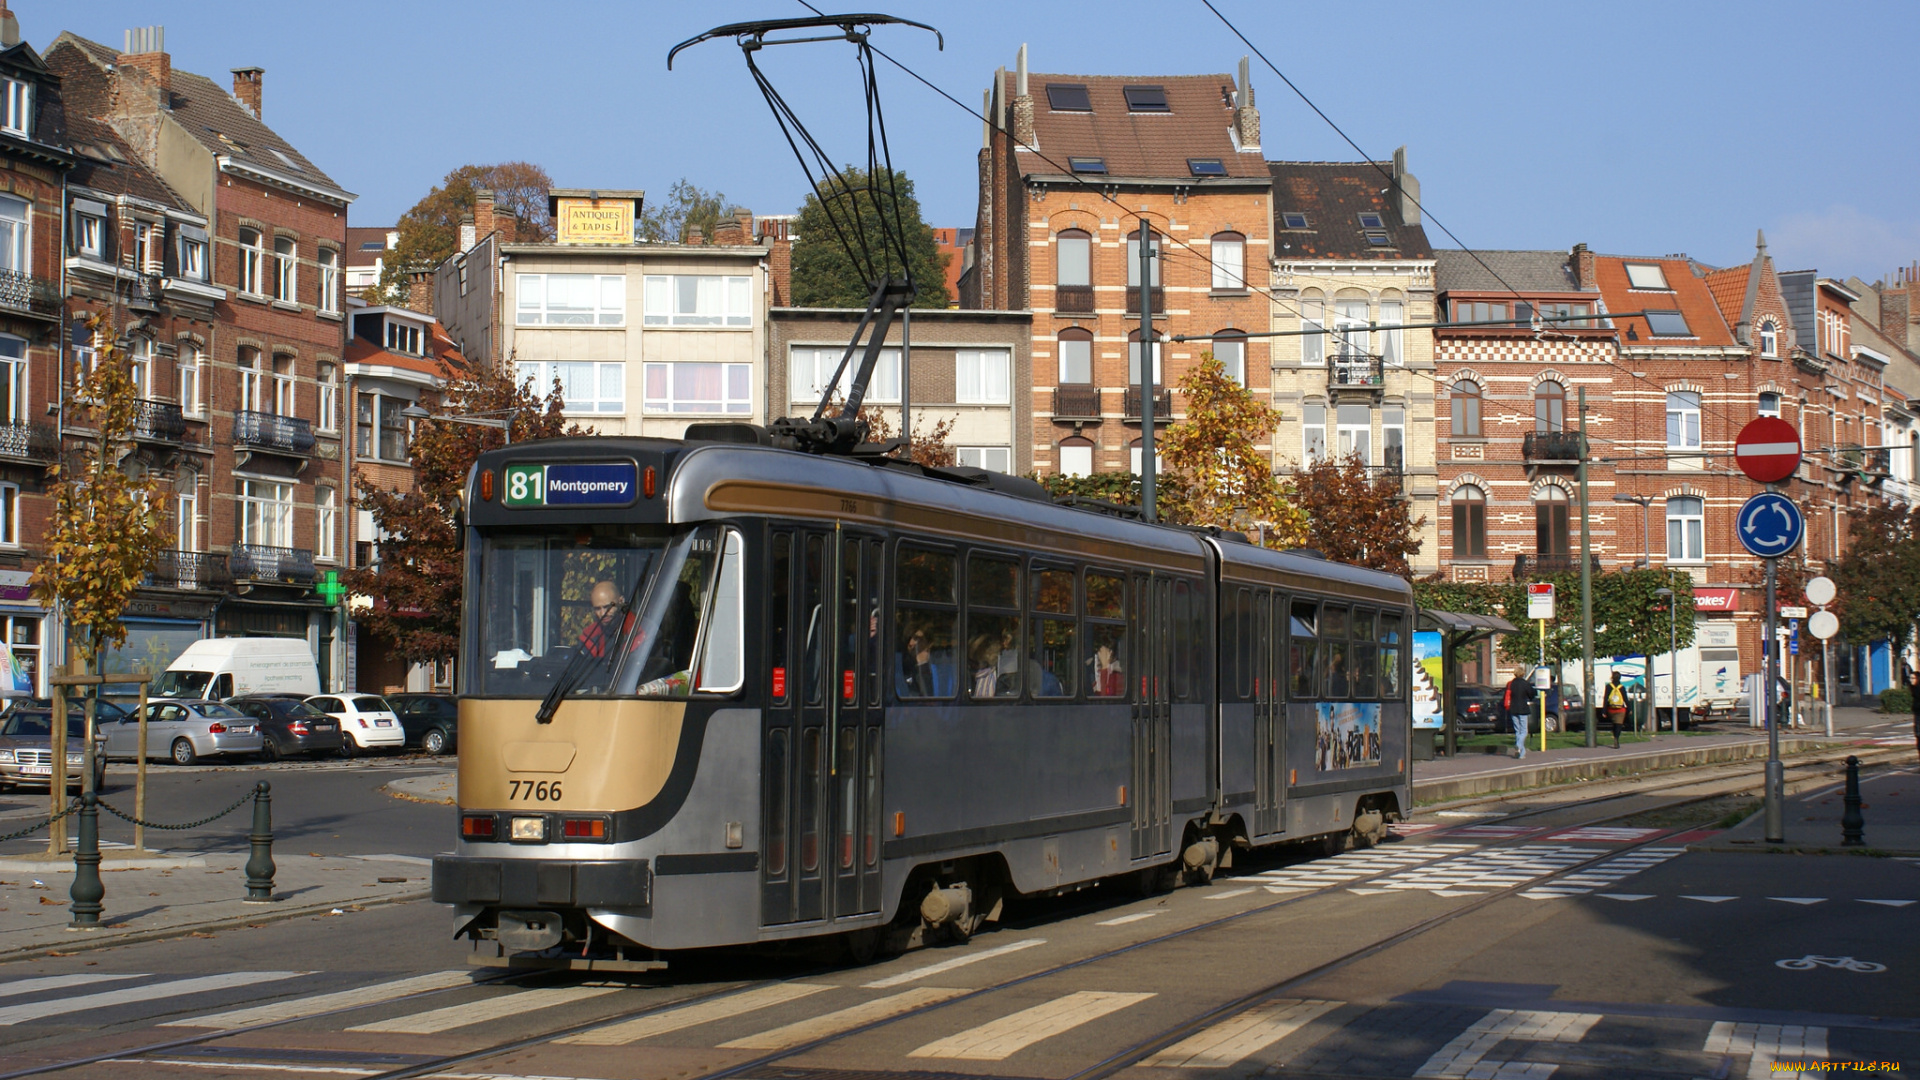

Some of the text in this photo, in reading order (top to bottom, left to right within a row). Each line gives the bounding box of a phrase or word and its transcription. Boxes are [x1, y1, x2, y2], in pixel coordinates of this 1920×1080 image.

[572, 210, 620, 220] ANTIQUES
[582, 222, 612, 231] TAPIS
[510, 471, 542, 500] 81
[549, 479, 628, 494] Montgomery
[509, 780, 563, 801] 7766
